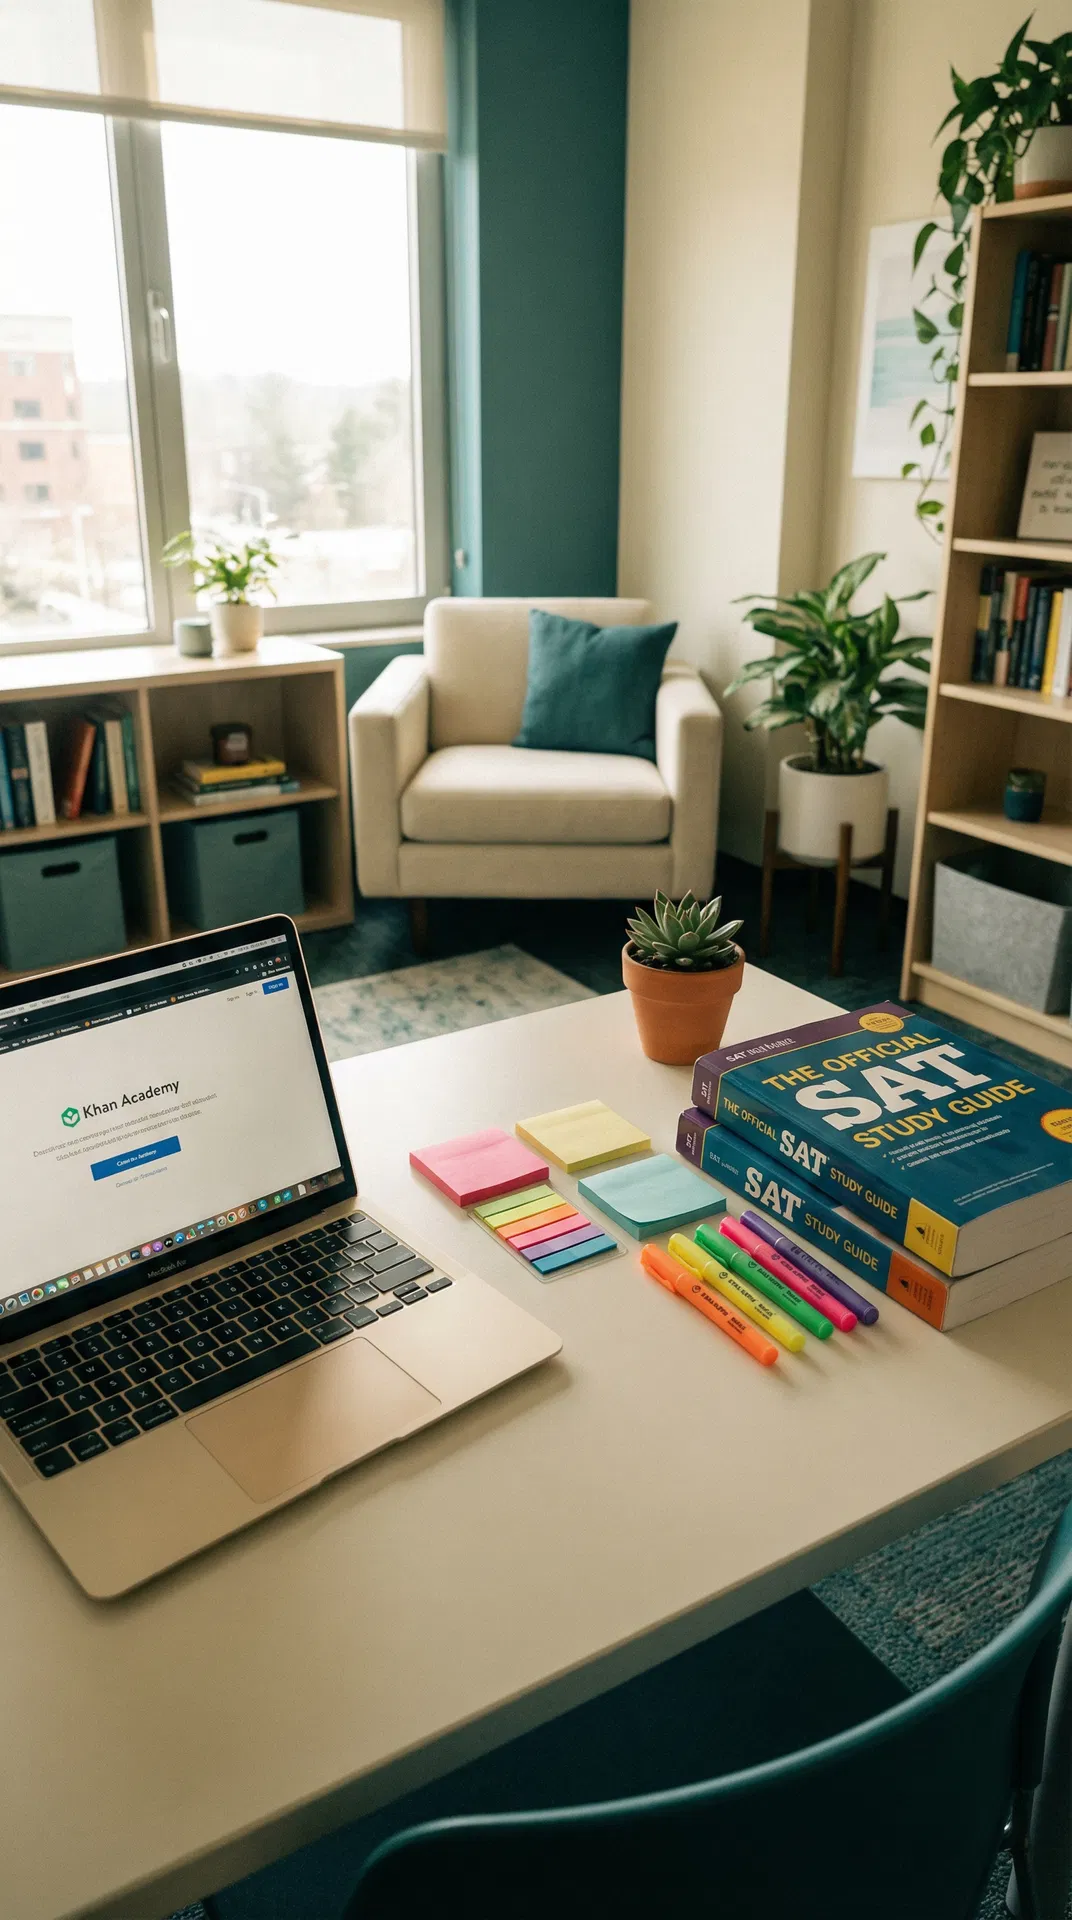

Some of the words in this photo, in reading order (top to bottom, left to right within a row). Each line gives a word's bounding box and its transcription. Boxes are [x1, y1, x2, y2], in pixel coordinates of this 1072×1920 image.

[726, 1051, 748, 1063] SAT
[762, 1065, 824, 1091] THE
[822, 1032, 941, 1072] OFFICIAL
[795, 1043, 992, 1131] SAT
[82, 1104, 118, 1119] Khan
[121, 1080, 180, 1108] Academy
[853, 1108, 948, 1150] STUDY
[948, 1079, 1036, 1116] GUIDE
[723, 1097, 739, 1116] THE
[741, 1109, 778, 1142] OFFICIAL
[779, 1130, 828, 1177] SAT
[830, 1167, 864, 1196] STUDY
[864, 1190, 899, 1220] GUIDE
[744, 1166, 801, 1222] SAT
[804, 1212, 840, 1244] STUDY
[843, 1239, 880, 1272] GUIDE
